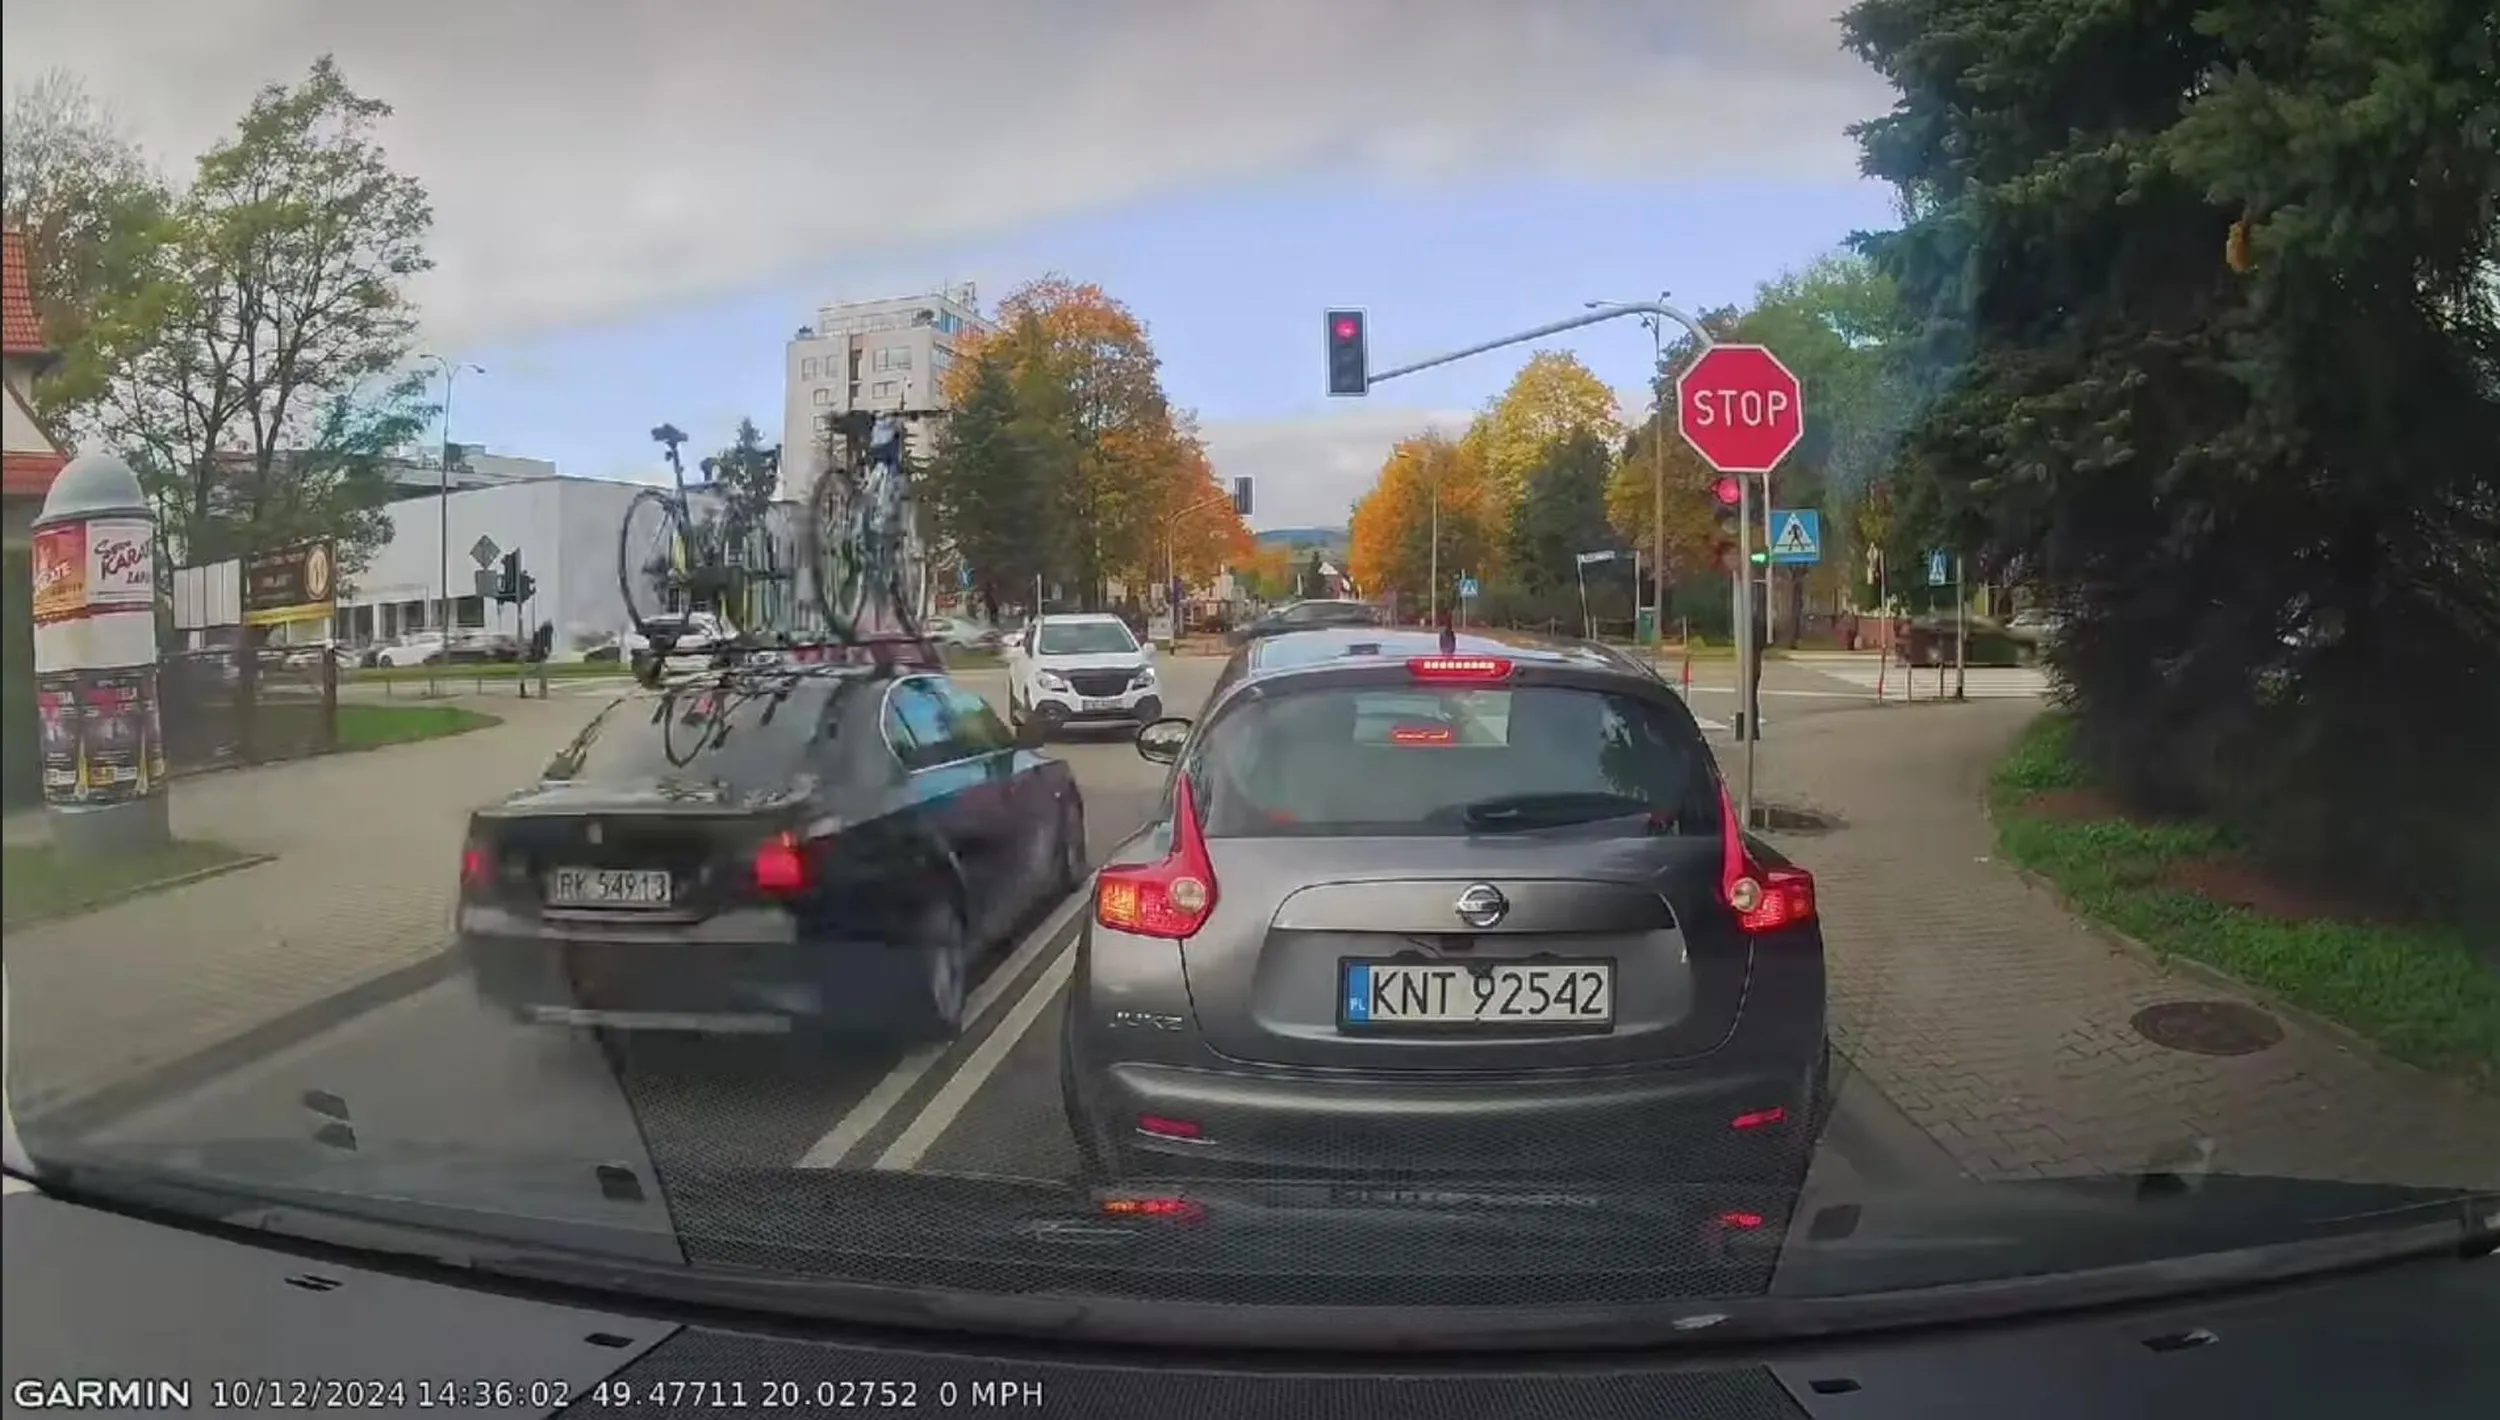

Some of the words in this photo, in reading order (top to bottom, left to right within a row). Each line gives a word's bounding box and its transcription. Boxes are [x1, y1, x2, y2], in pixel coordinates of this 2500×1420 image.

[1693, 388, 1789, 428] STOP
[560, 871, 586, 900] RK
[597, 871, 667, 901] 54913
[1349, 996, 1367, 1011] PL
[1372, 971, 1456, 1015] KNT
[1472, 971, 1604, 1015] 92542
